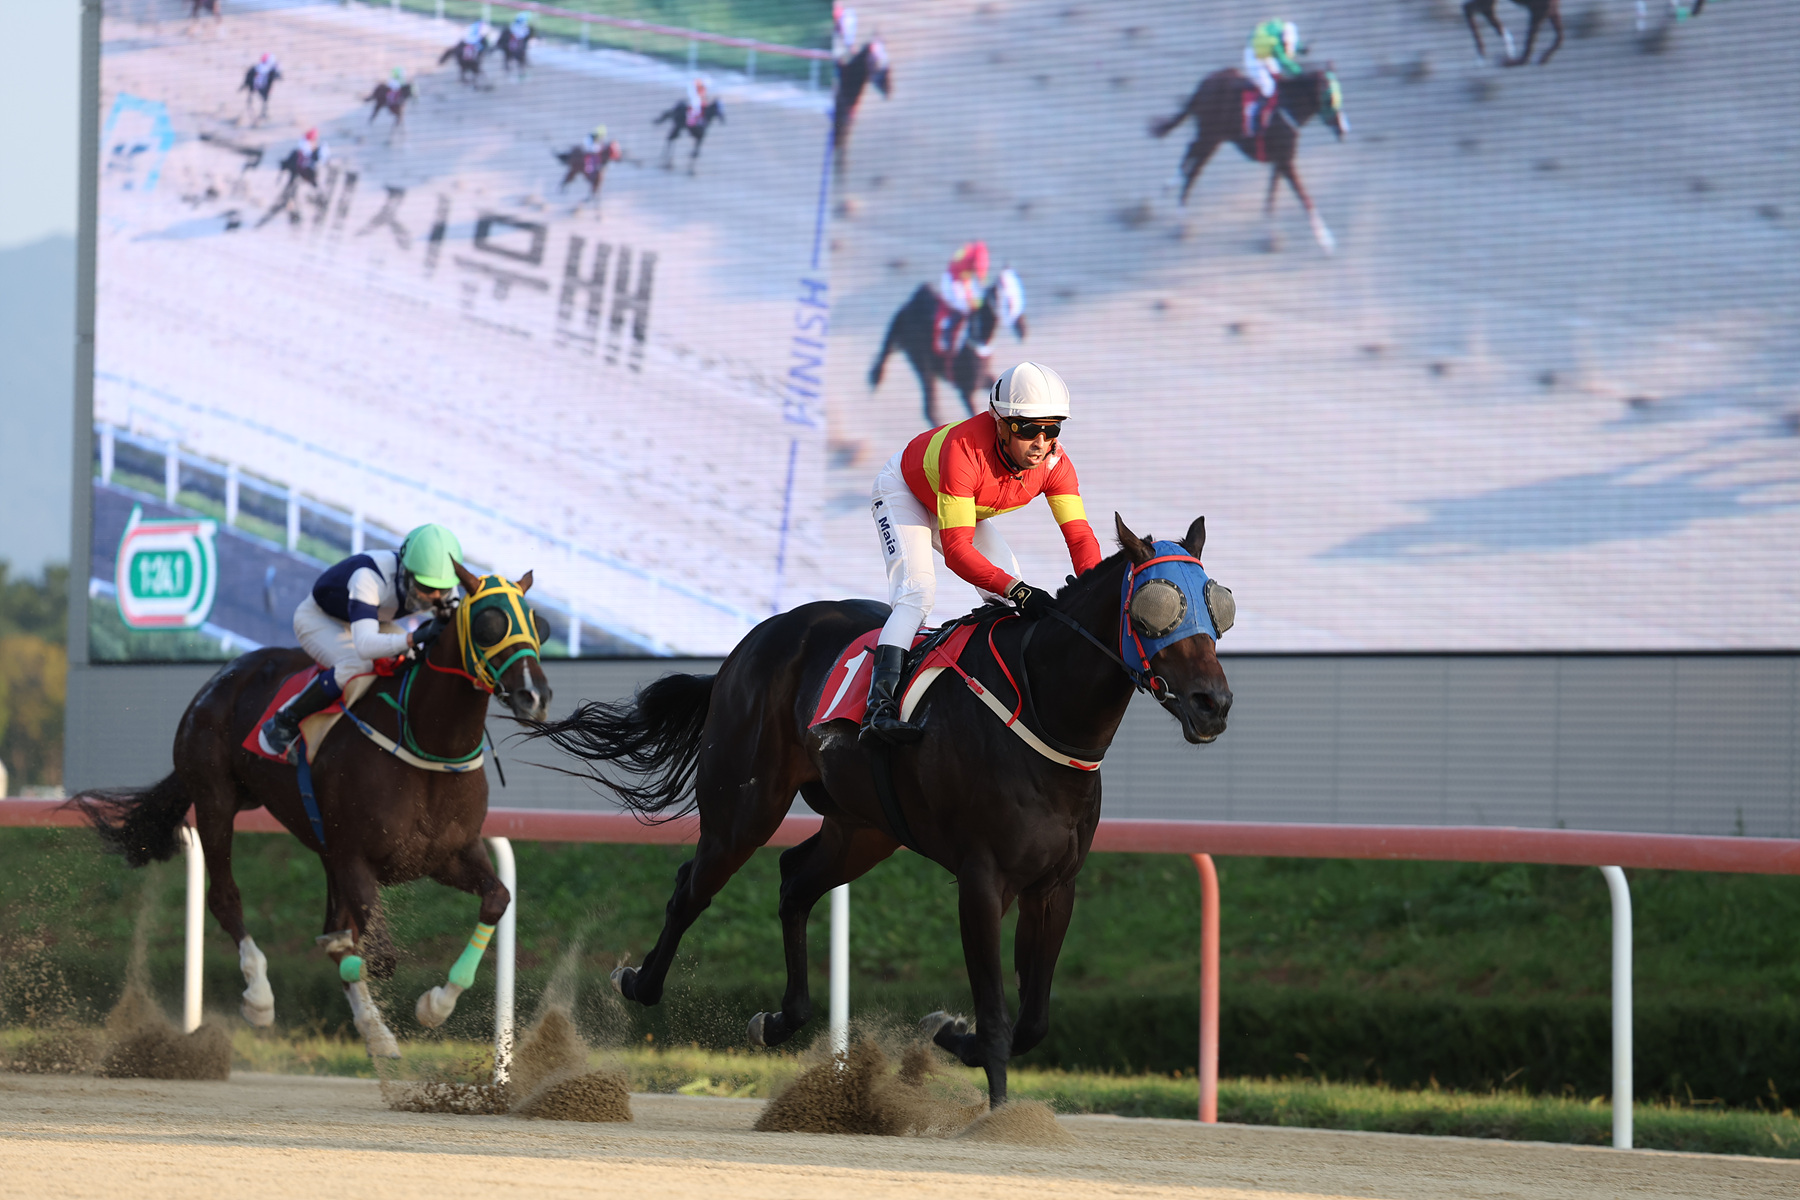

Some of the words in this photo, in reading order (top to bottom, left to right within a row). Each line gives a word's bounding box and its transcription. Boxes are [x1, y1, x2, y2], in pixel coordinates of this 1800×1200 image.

[783, 278, 830, 429] FINISH
[878, 516, 896, 556] Maia
[820, 649, 869, 720] 1
